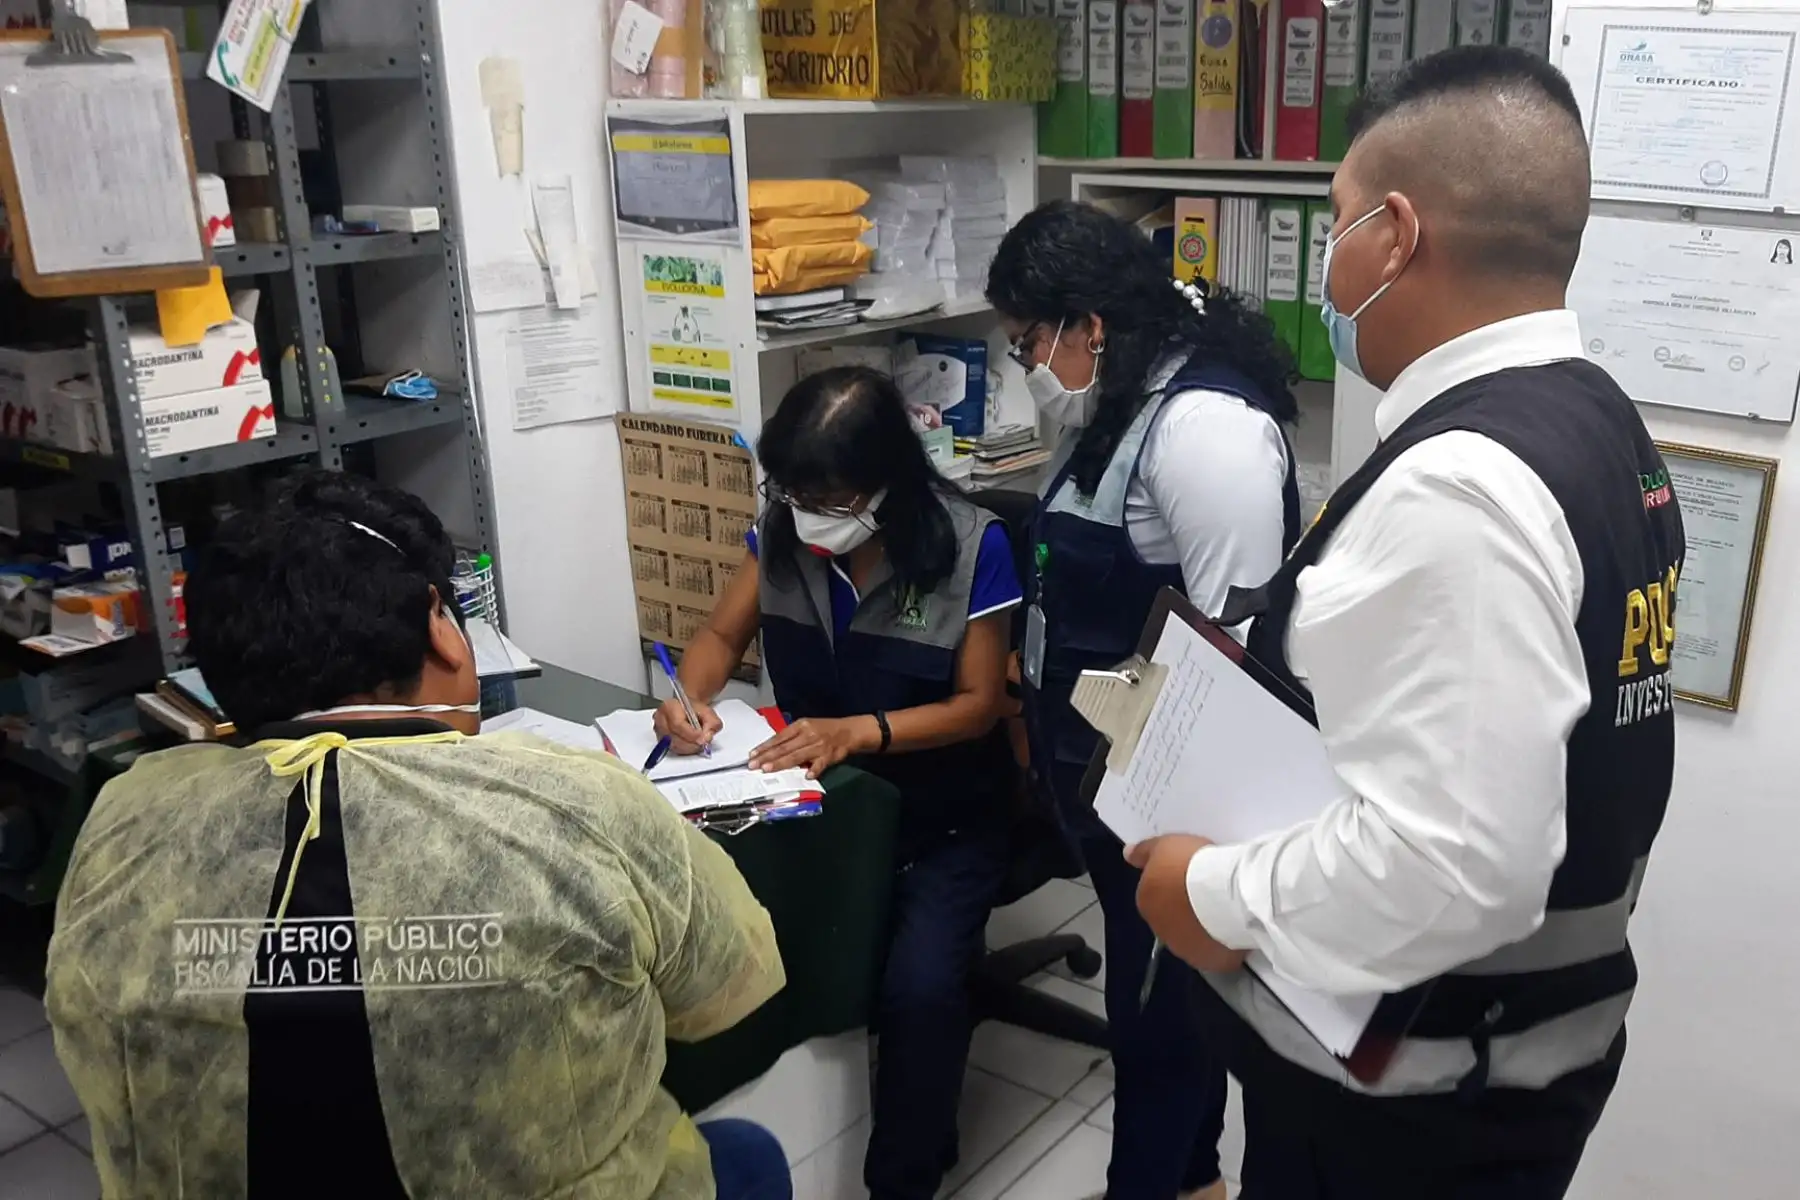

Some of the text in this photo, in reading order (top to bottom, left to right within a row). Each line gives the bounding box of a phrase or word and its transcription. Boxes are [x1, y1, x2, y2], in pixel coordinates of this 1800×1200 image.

[764, 49, 869, 86] ESCRITORIO
[1636, 76, 1739, 89] CERTIFICADO
[145, 407, 219, 425] MACRODANTINA
[621, 418, 684, 438] CALENDARIO
[686, 428, 726, 445] EUREKA
[174, 917, 503, 956] MINISTERIO PÚBLICO
[174, 948, 505, 988] FISCALÍA DE LA NACIÓN
